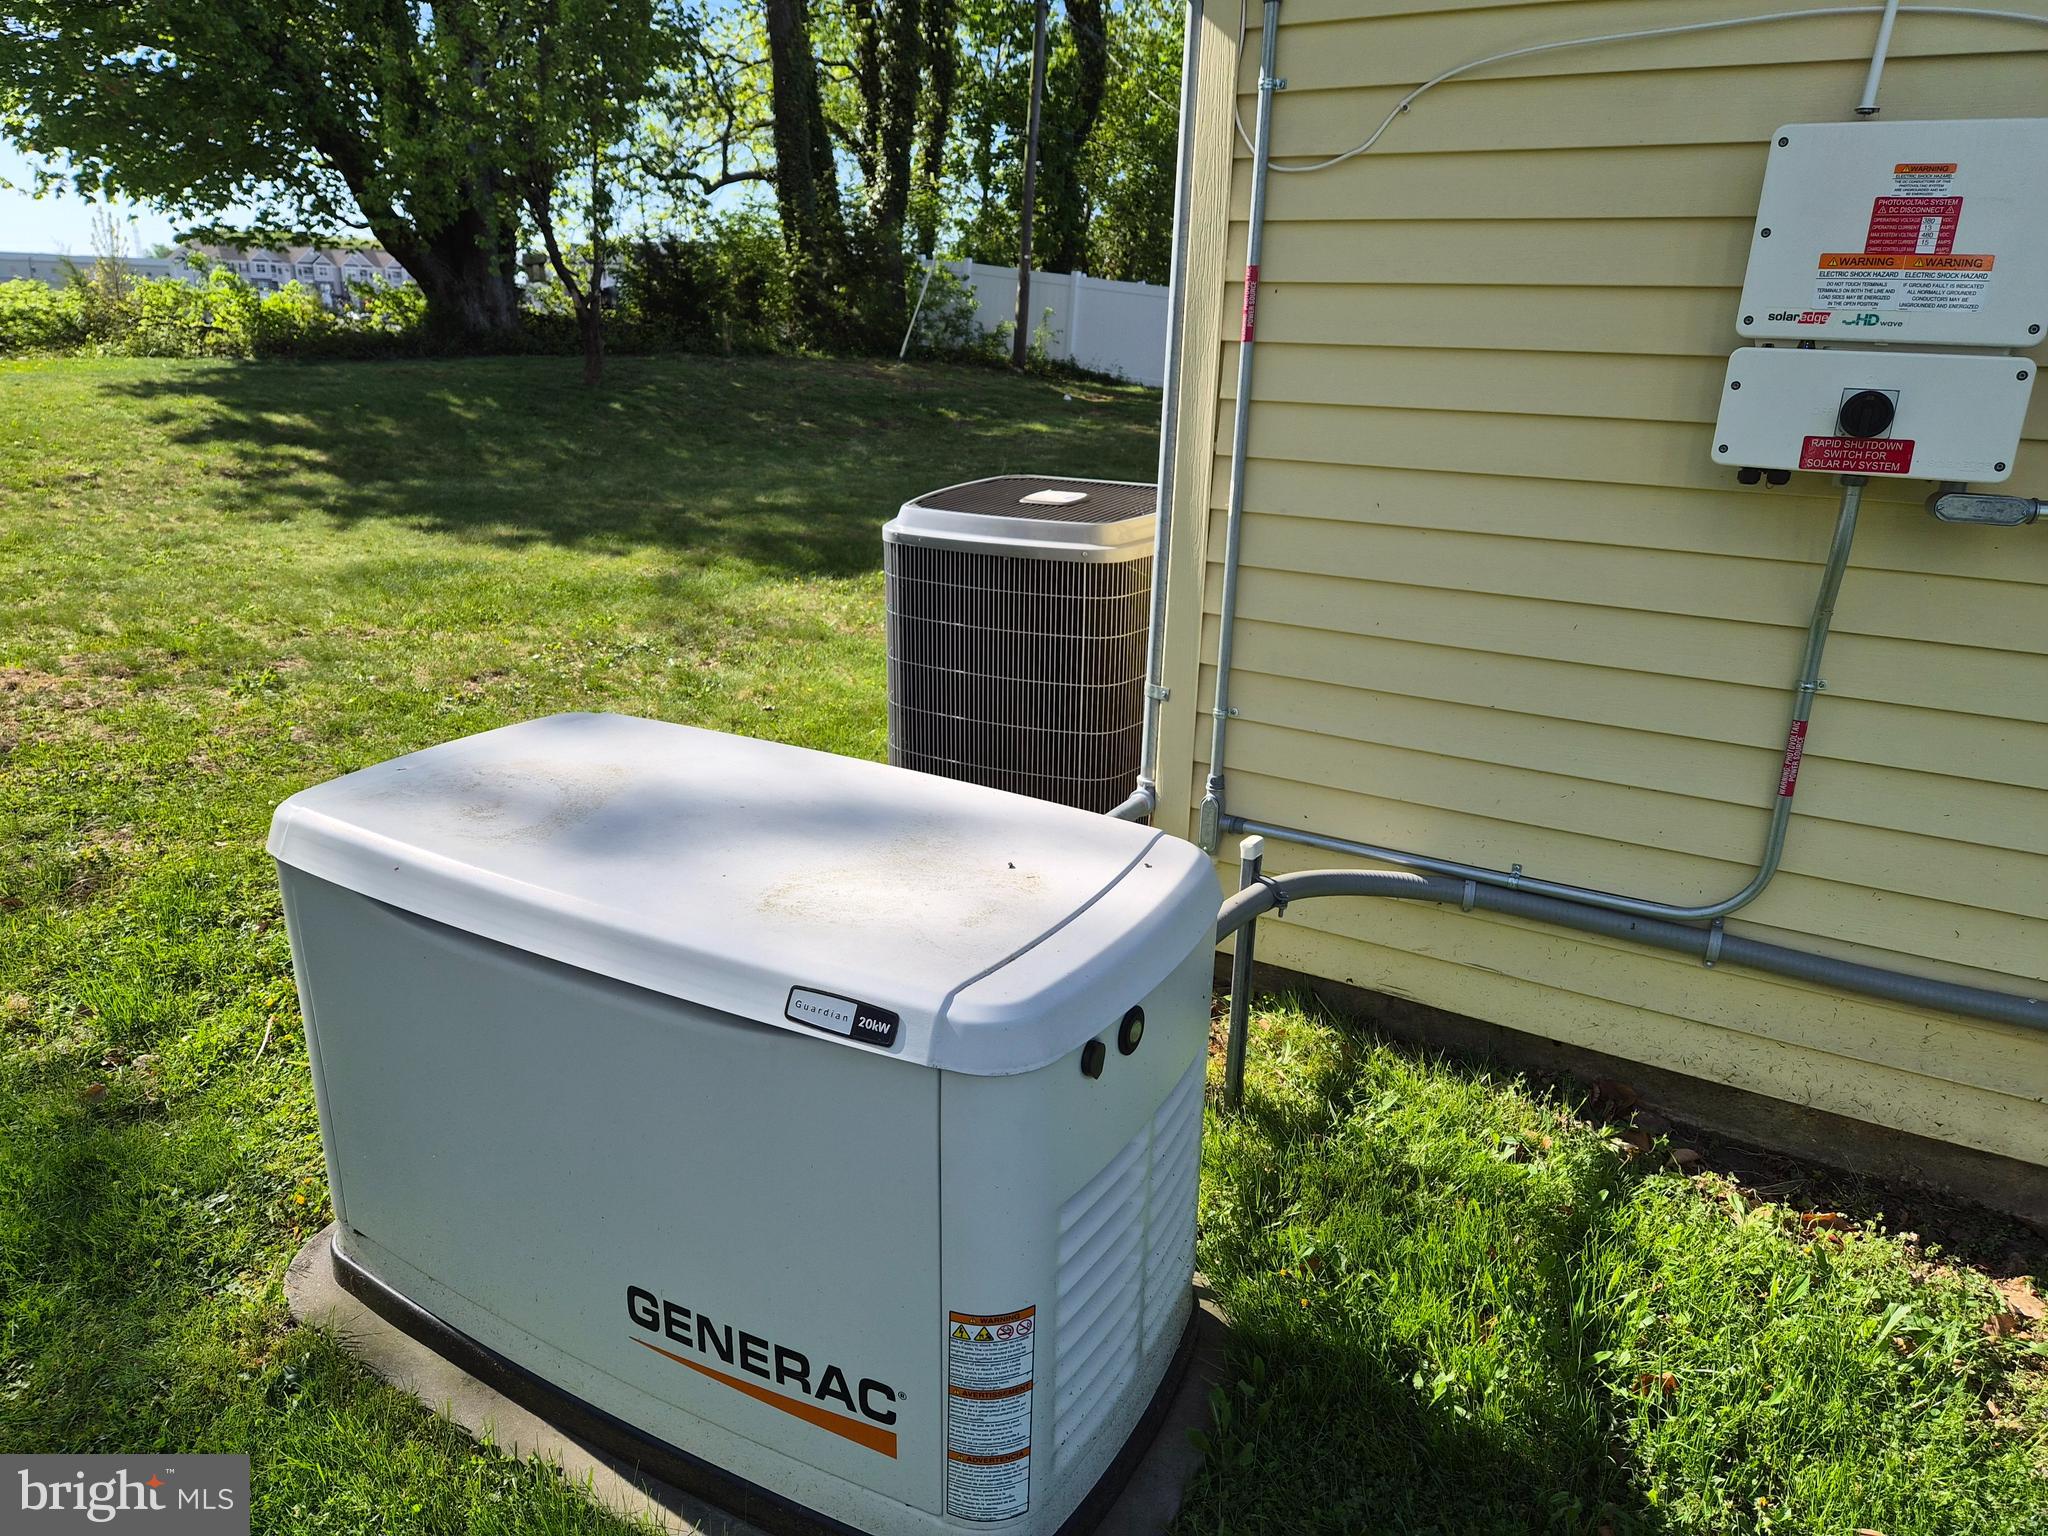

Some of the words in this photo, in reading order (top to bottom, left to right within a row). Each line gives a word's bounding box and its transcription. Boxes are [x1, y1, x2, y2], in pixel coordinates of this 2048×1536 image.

[1839, 257, 1894, 266] WARNING
[1926, 258, 1983, 268] WARNING
[1249, 281, 1257, 304] SOURCE
[1856, 314, 1880, 326] HD
[1811, 439, 1841, 448] RAPID
[1843, 440, 1903, 450] SHUTDOWN
[1824, 450, 1861, 459] SWITCH
[1865, 451, 1886, 460] FOR
[1807, 458, 1840, 468] SOLAR
[1842, 460, 1857, 468] PV
[1858, 461, 1900, 471] SYSTEM
[1785, 720, 1800, 765] PHOTOVOLTAIC
[1793, 736, 1804, 760] SOURCE
[1788, 760, 1799, 782] POWER
[795, 1000, 848, 1022] Guardian
[858, 1016, 891, 1034] 20kW
[980, 1313, 1020, 1324] WARNING
[627, 1285, 897, 1426] GENERAC
[962, 1382, 1030, 1398] AVERTISSEMENT
[966, 1452, 1024, 1464] ADVERTENCIA
